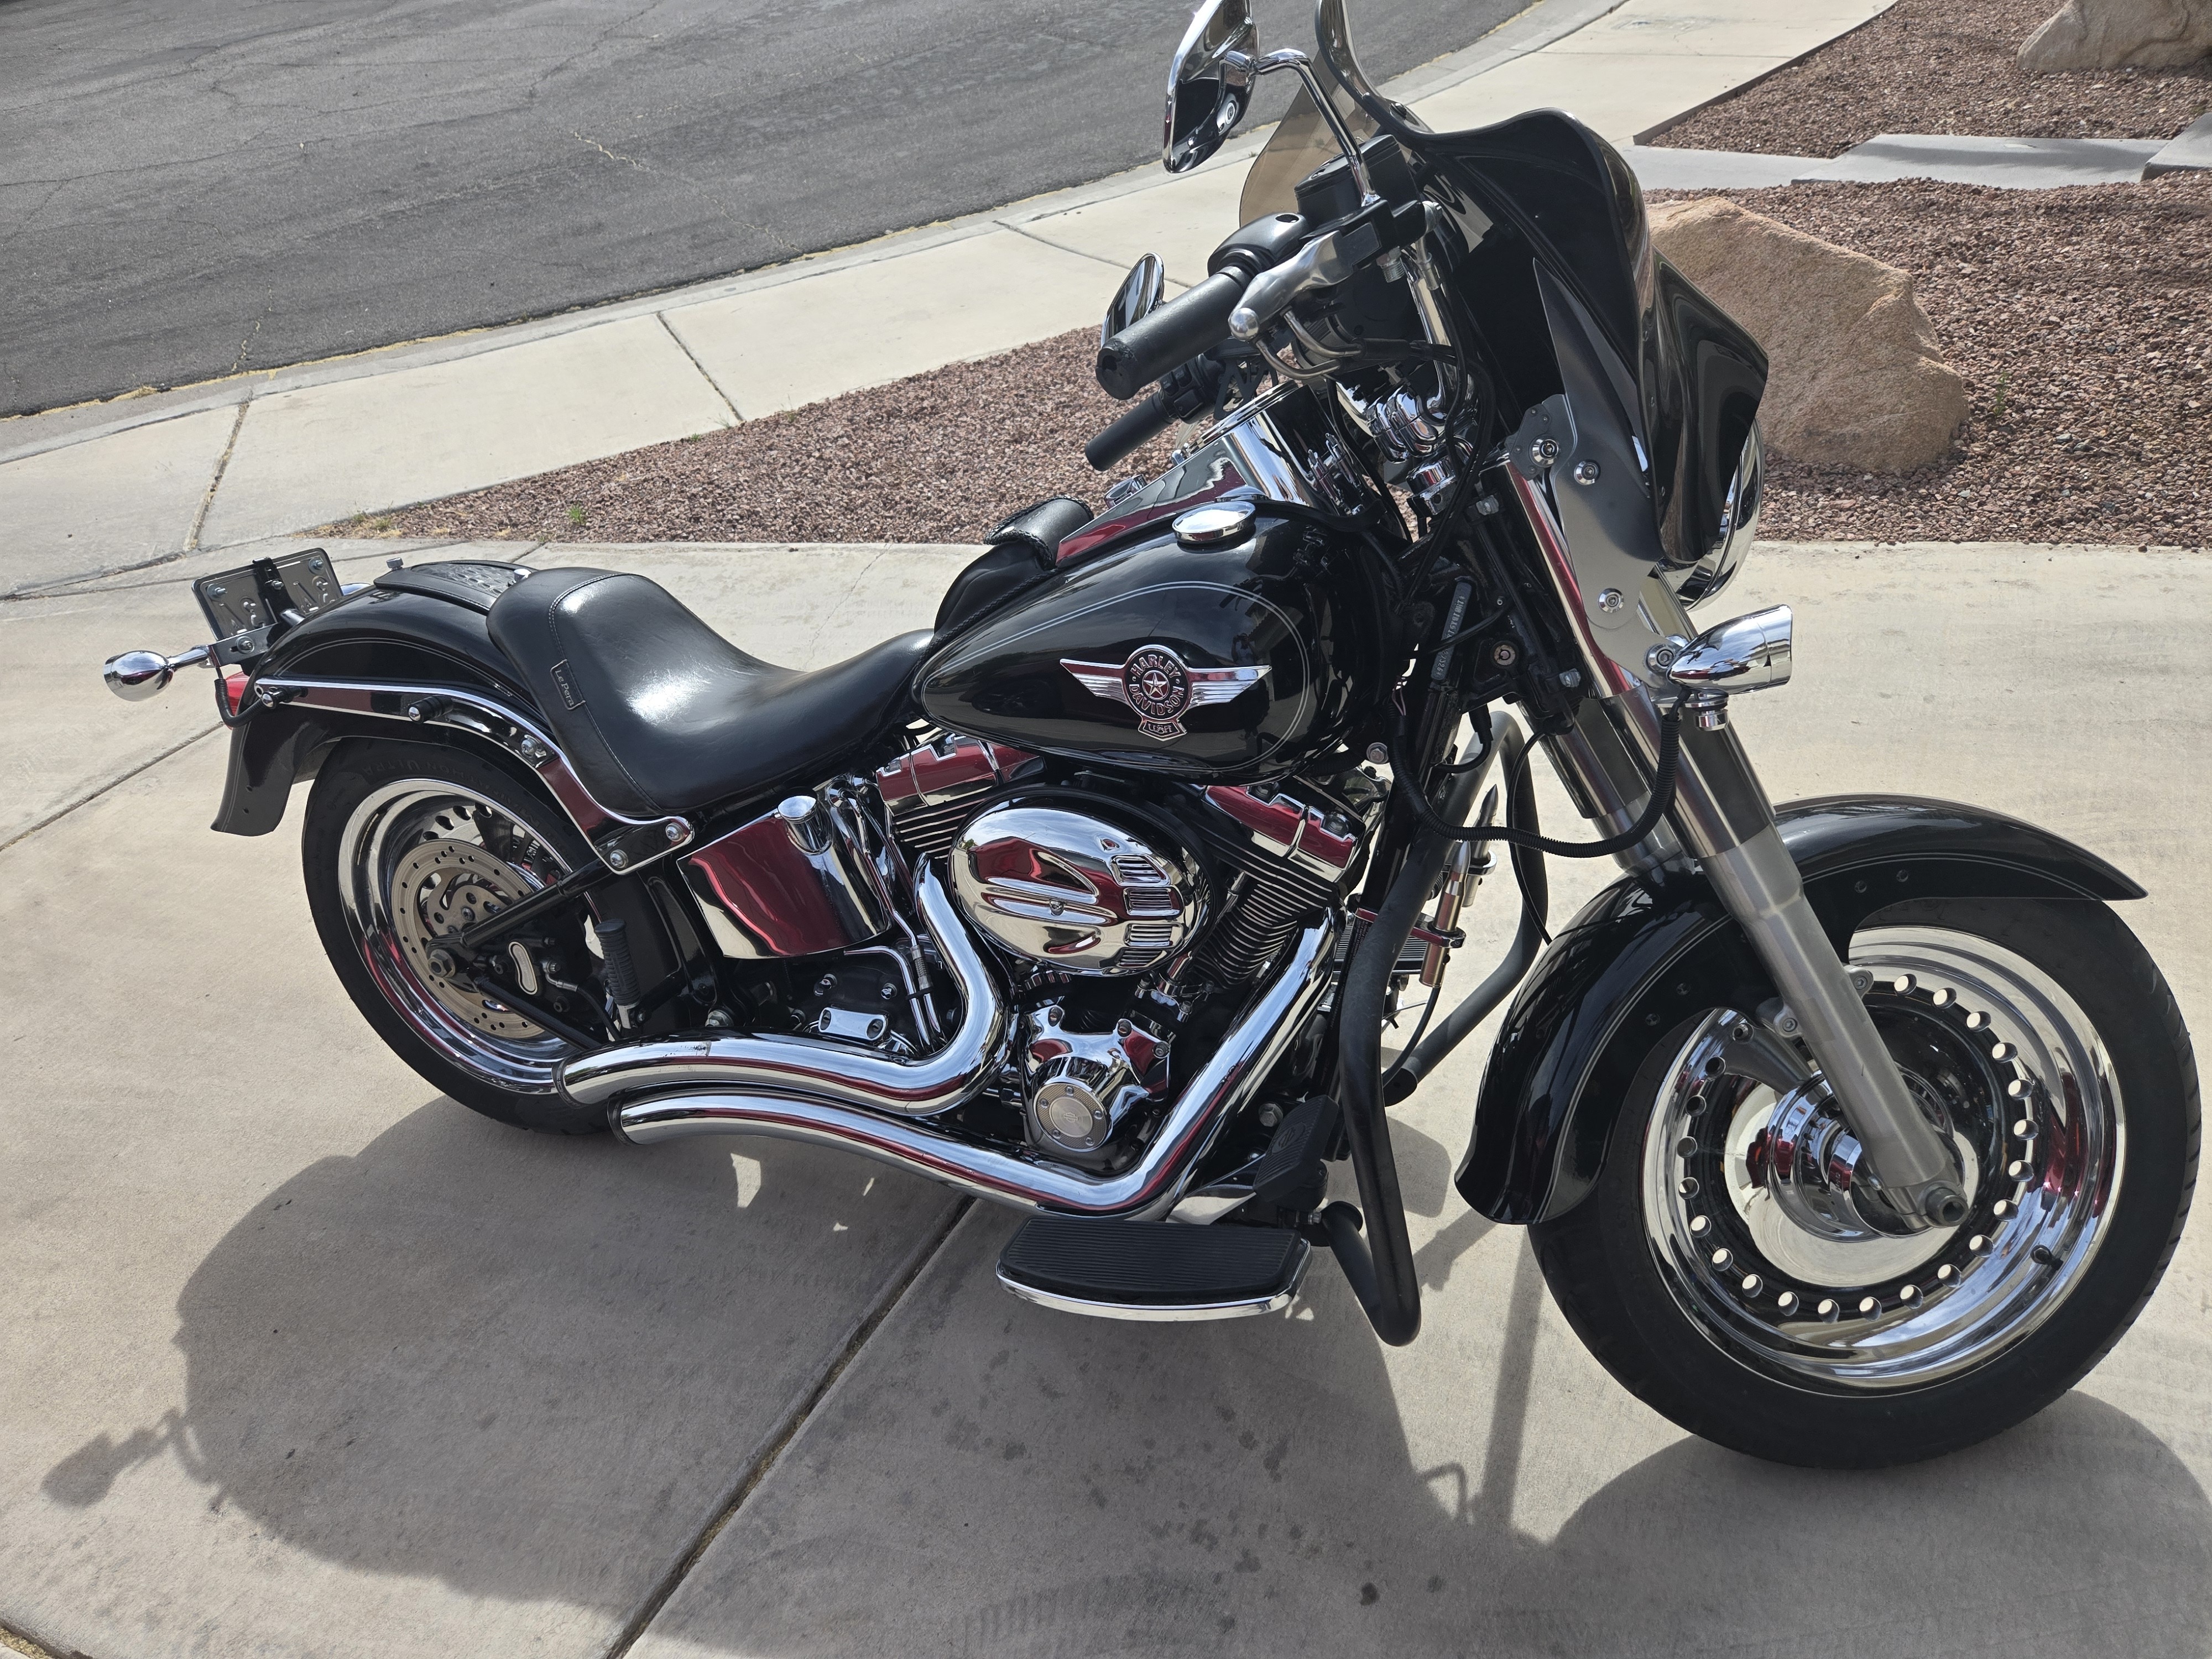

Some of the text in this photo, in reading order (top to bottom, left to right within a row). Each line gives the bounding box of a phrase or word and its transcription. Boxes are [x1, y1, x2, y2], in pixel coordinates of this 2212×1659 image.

[1131, 654, 1181, 678] HARLEY
[1129, 684, 1185, 716] DAVIDSON
[1147, 724, 1172, 733] USA
